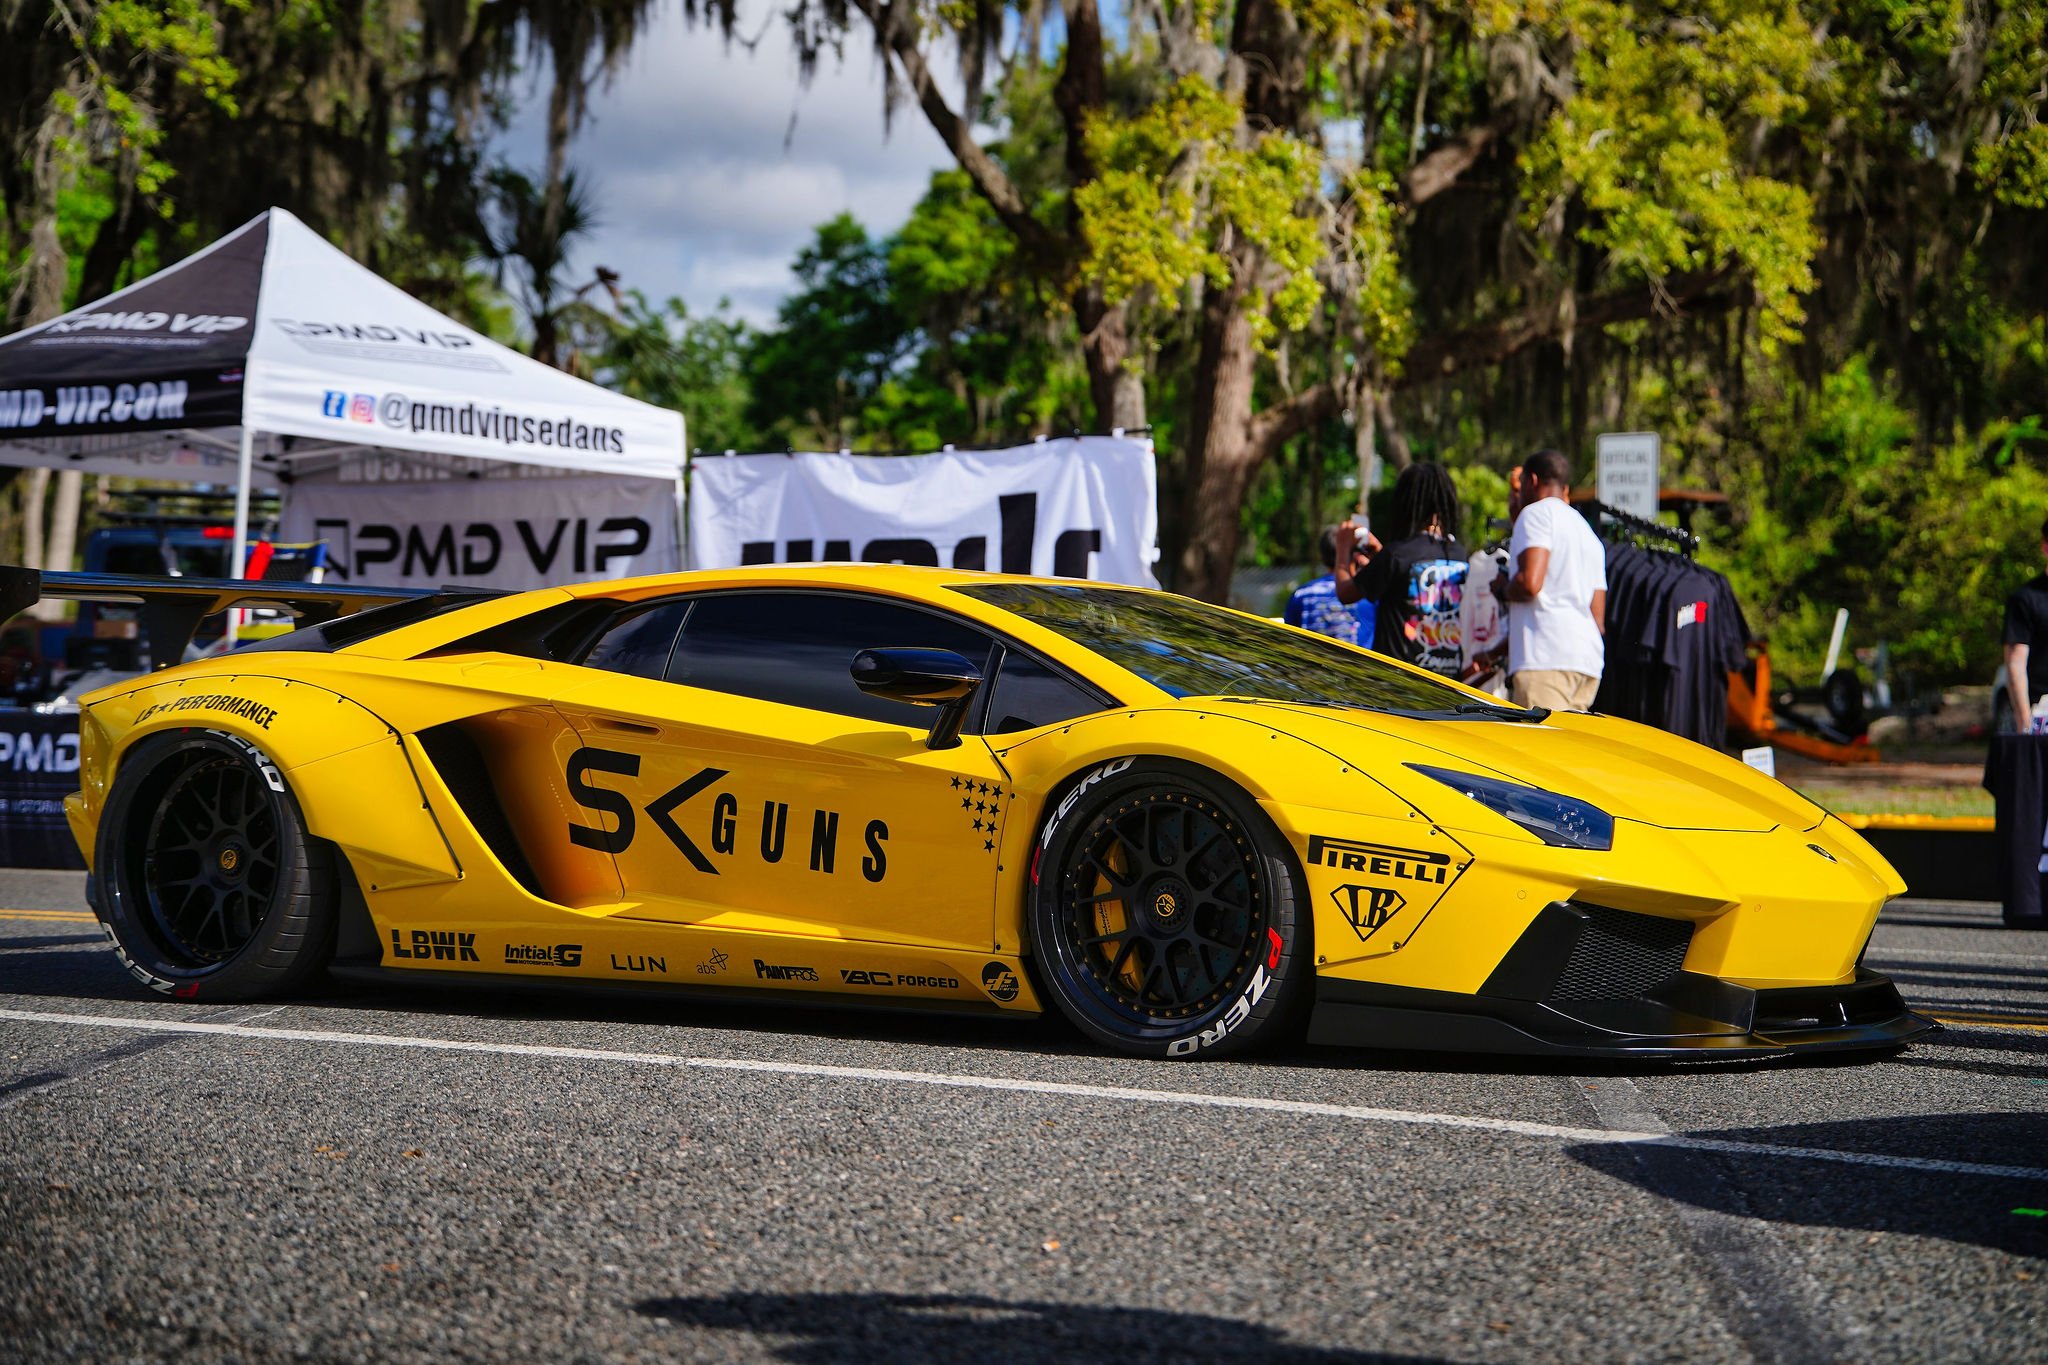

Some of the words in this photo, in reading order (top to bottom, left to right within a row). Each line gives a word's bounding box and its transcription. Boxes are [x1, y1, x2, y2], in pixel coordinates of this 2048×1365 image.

[169, 314, 248, 333] VIP
[302, 323, 397, 341] PMD
[396, 327, 471, 348] VIP
[380, 392, 625, 454] @pmdvipsedans
[355, 524, 501, 577] PMD
[515, 517, 650, 575] VIP
[132, 703, 155, 727] LB
[169, 695, 278, 731] PERFORMANCE
[1041, 756, 1137, 850] ZERO
[711, 792, 889, 883] GUNS
[1307, 834, 1451, 884] PIRELLI
[101, 922, 176, 995] ZERO
[392, 929, 480, 962] LBWK
[611, 954, 667, 973] LUN
[1267, 927, 1283, 970] P
[696, 961, 717, 975] abs
[897, 975, 959, 989] FORGED
[176, 982, 200, 998] P
[1167, 964, 1271, 1057] ZERO
